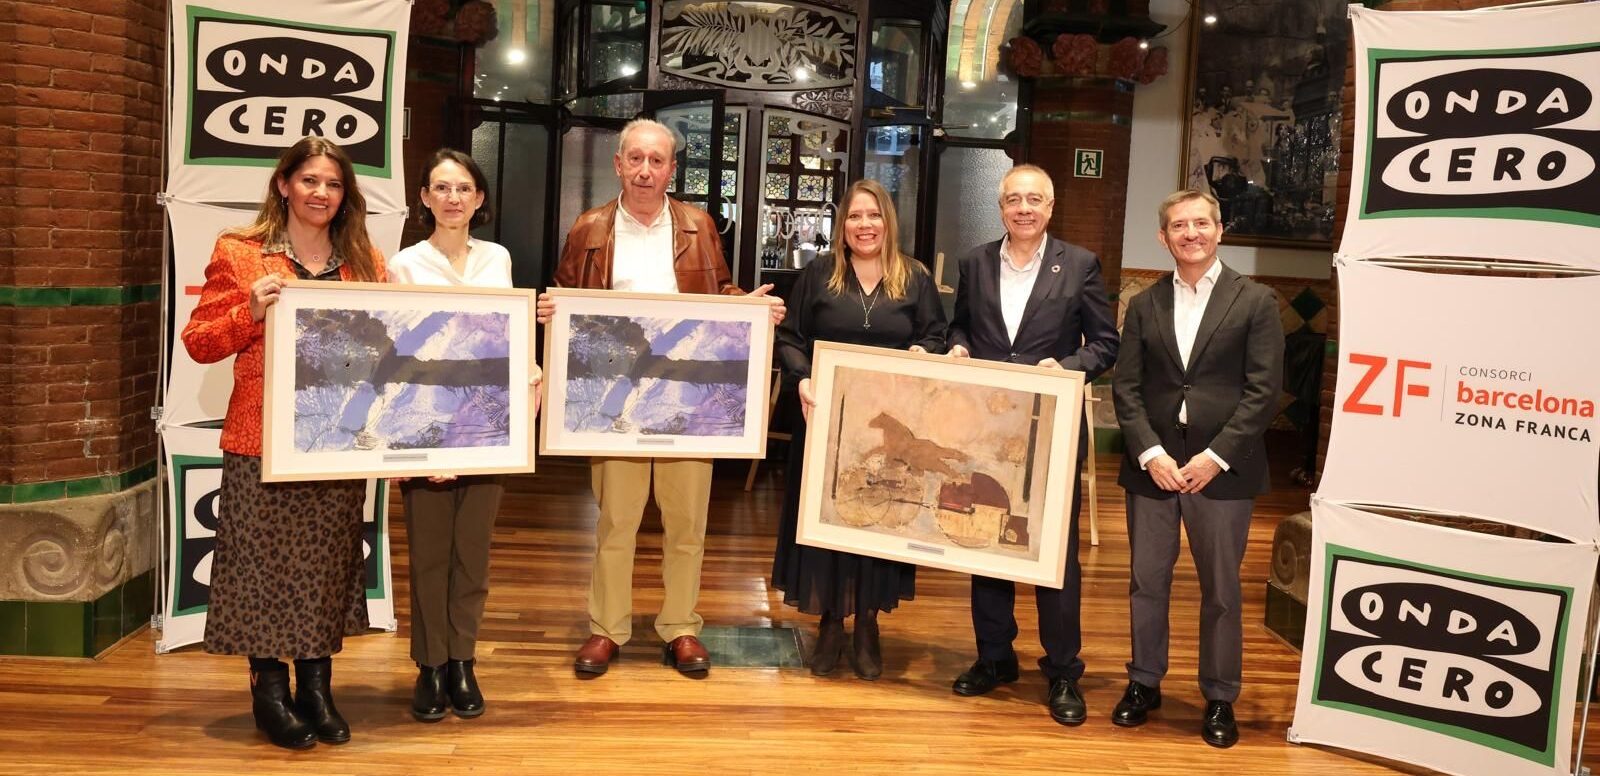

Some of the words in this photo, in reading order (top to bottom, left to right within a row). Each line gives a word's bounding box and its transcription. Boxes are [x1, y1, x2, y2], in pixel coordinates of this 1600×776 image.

[223, 50, 358, 84] ONDA
[1405, 87, 1569, 120] ONDA
[229, 104, 358, 139] CERO
[1409, 147, 1567, 182] CERO
[1342, 352, 1432, 418] ZF
[1459, 366, 1532, 382] CONSORCI
[1457, 380, 1595, 418] barcelona
[1455, 412, 1507, 431] ZONA
[1515, 419, 1592, 442] FRANCA
[1359, 591, 1518, 647] ONDA
[1361, 651, 1514, 710] CERO
